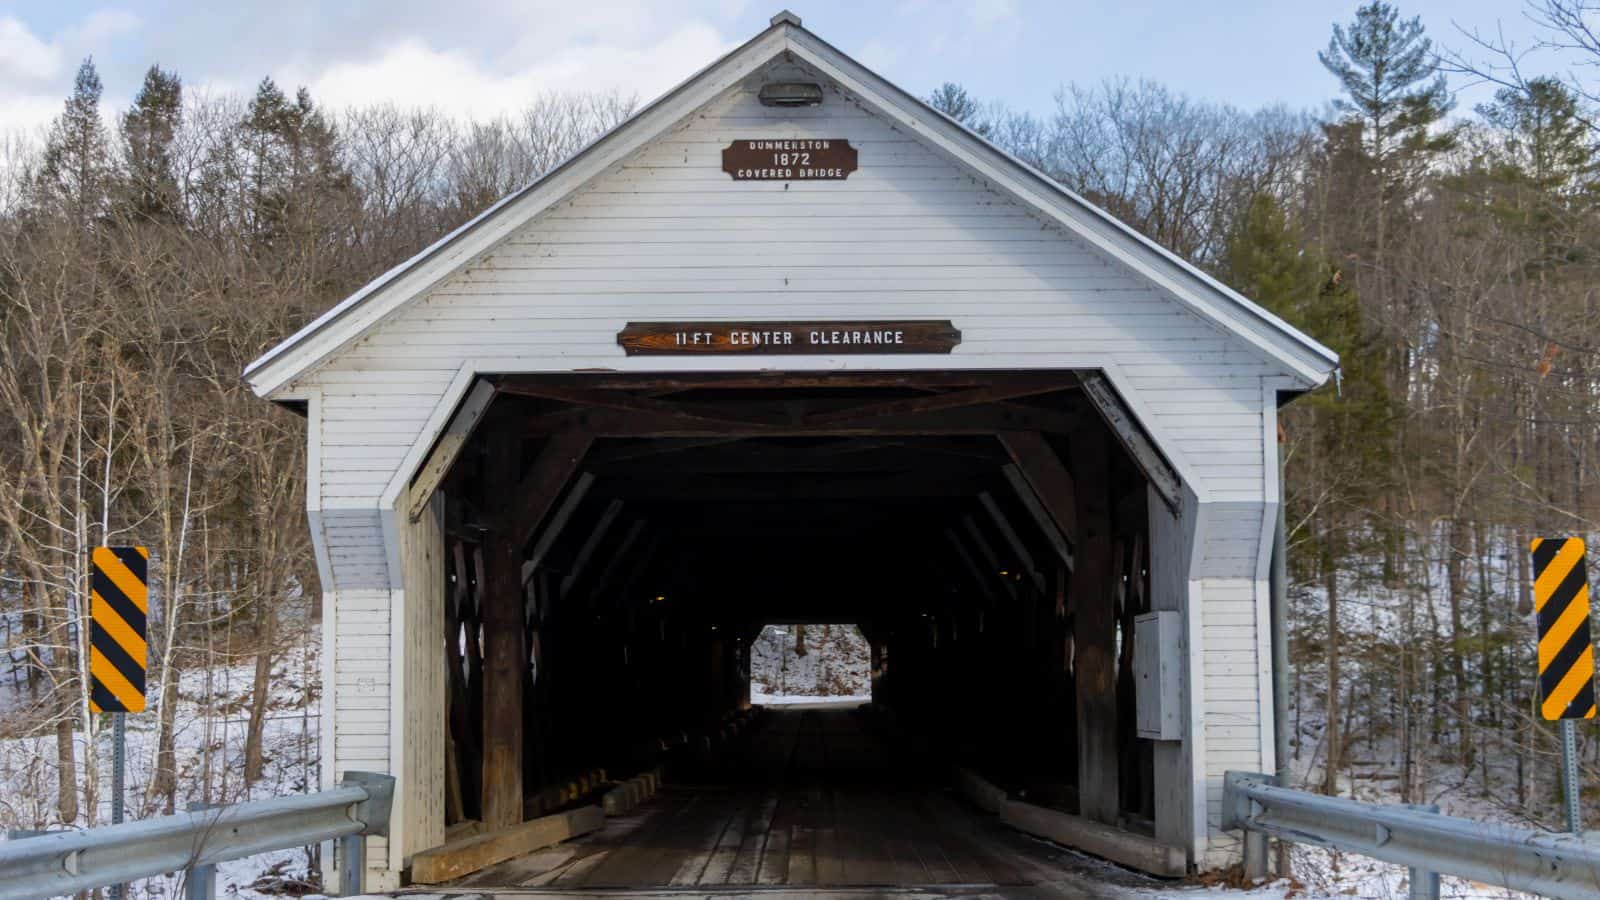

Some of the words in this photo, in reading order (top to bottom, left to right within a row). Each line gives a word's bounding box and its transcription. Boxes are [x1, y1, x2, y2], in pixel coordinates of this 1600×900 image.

[749, 141, 830, 150] DUMMERSTON
[774, 153, 811, 165] 1872
[738, 169, 792, 178] COVERED
[800, 168, 842, 177] BRIDGE
[730, 331, 792, 345] CENTER
[810, 331, 904, 344] CLEARANCE
